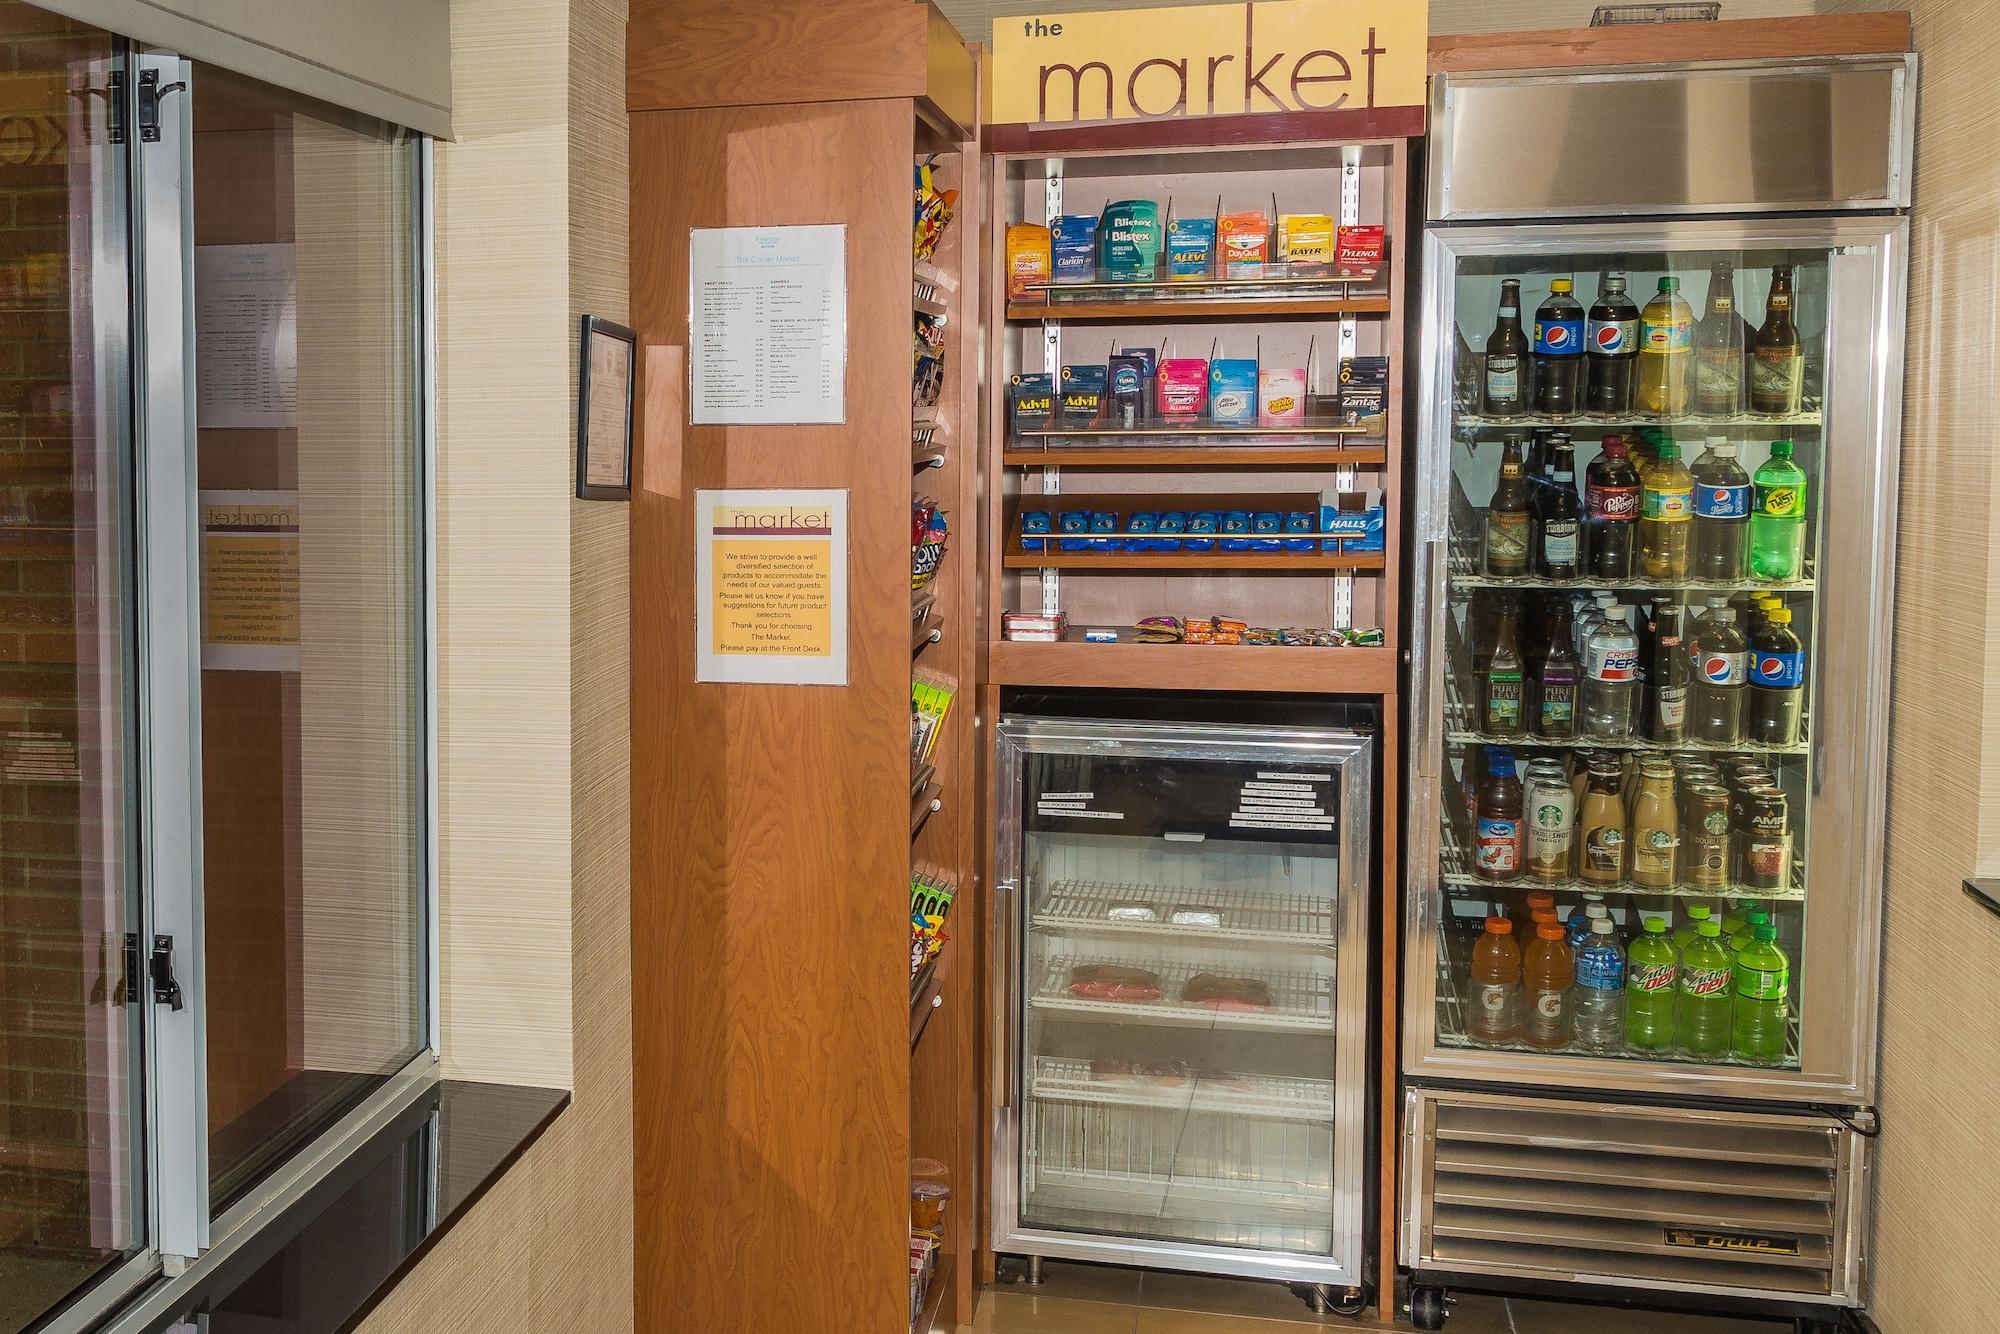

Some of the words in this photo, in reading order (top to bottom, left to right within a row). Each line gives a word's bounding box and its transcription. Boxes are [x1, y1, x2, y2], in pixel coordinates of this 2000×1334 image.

[1024, 19, 1063, 37] the
[1039, 2, 1386, 122] market
[1114, 218, 1152, 227] Blistex
[1112, 231, 1150, 243] Blistex
[1228, 249, 1260, 258] DayQuil
[1291, 248, 1322, 256] BAYER
[1341, 249, 1378, 257] TYLENOL
[1057, 258, 1084, 266] Claritin
[1173, 252, 1207, 263] ALEVE
[1017, 398, 1050, 410] Advil
[1064, 395, 1098, 407] Advil
[1268, 397, 1294, 407] Pepto
[1342, 397, 1381, 407] Zantac
[1615, 496, 1627, 505] Dr
[1606, 499, 1634, 513] Pepper
[735, 506, 829, 528] market
[1329, 519, 1367, 529] HALLS
[769, 553, 795, 562] provide
[723, 572, 753, 580] products
[807, 592, 824, 600] have
[722, 602, 764, 610] suggestions
[800, 602, 827, 611] product
[780, 622, 813, 631] choosing
[1492, 685, 1519, 693] PURE
[1752, 816, 1784, 824] AMP
